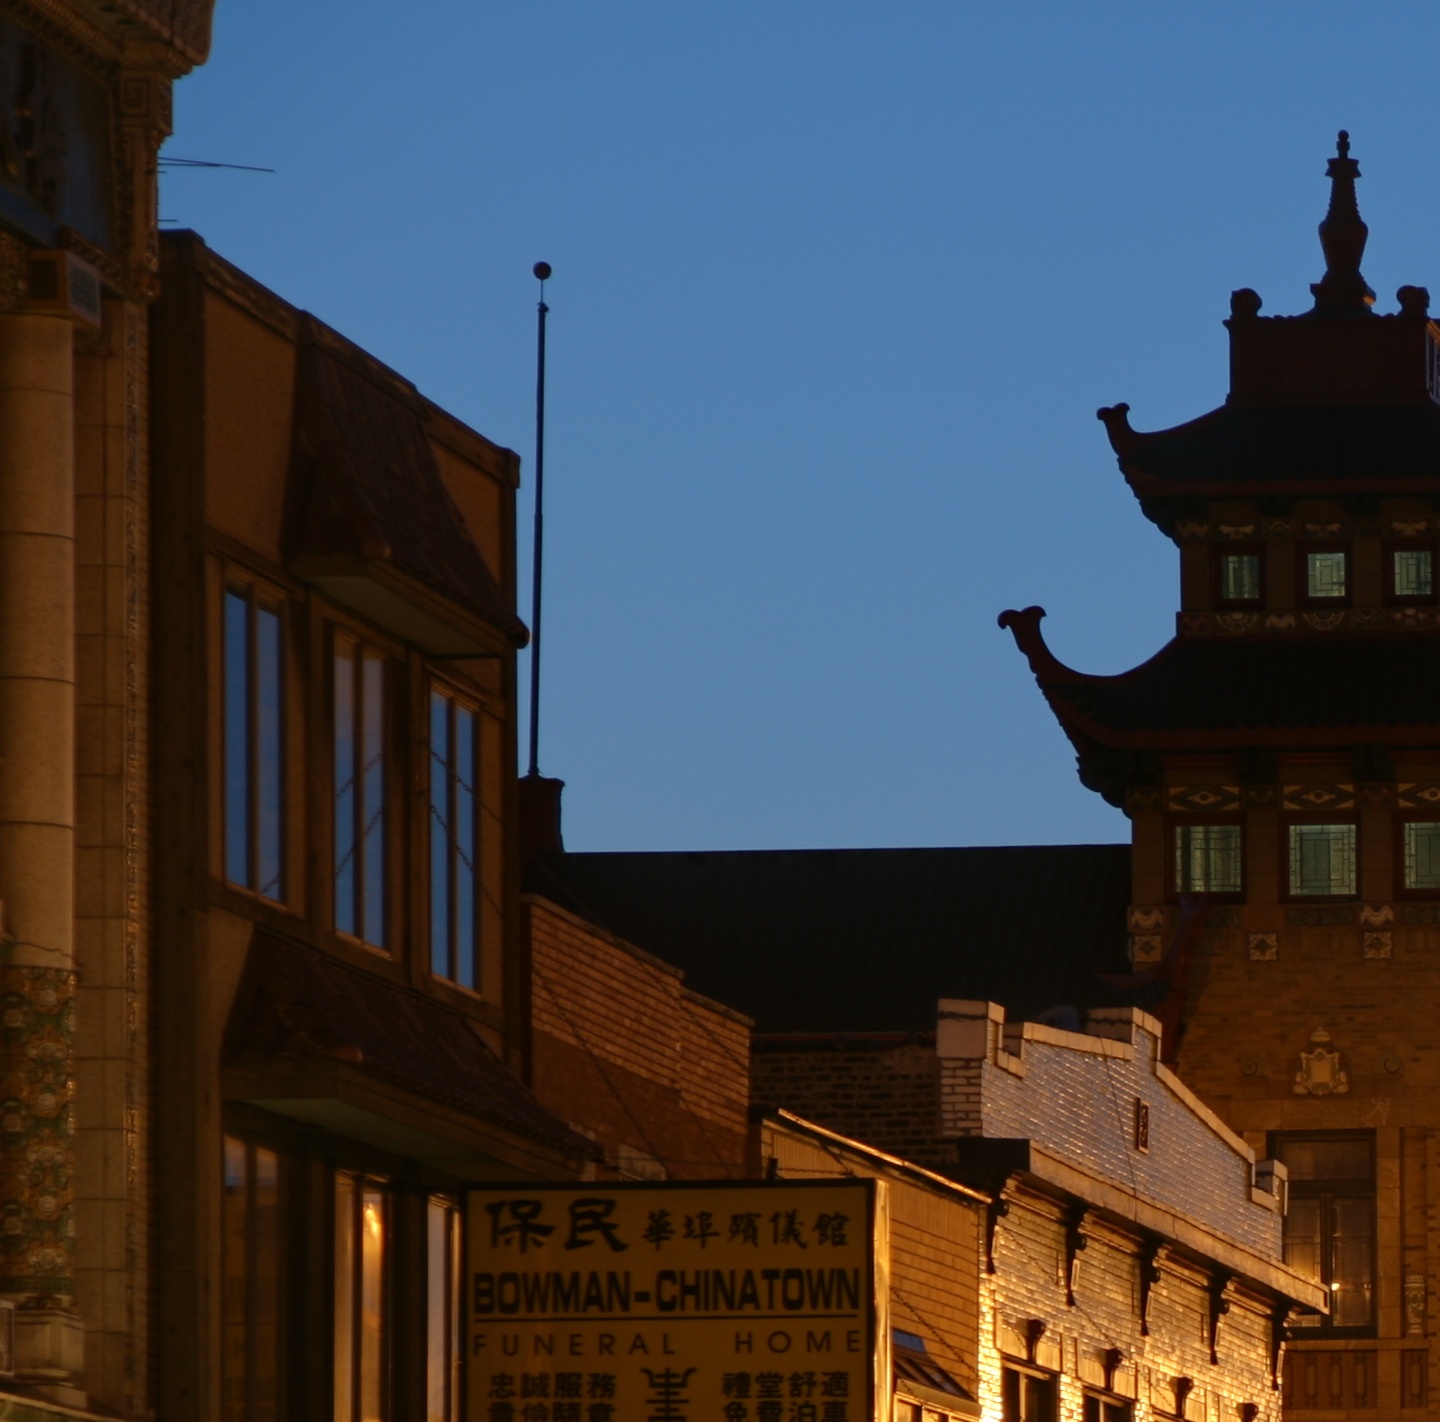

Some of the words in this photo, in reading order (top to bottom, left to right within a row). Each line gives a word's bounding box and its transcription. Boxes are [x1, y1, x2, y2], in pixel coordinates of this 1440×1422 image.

[486, 1197, 631, 1254] 保民
[473, 1267, 860, 1314] BOWMAN-CHINATOWN
[473, 1332, 677, 1357] FUNERAL
[734, 1330, 862, 1354] HOME
